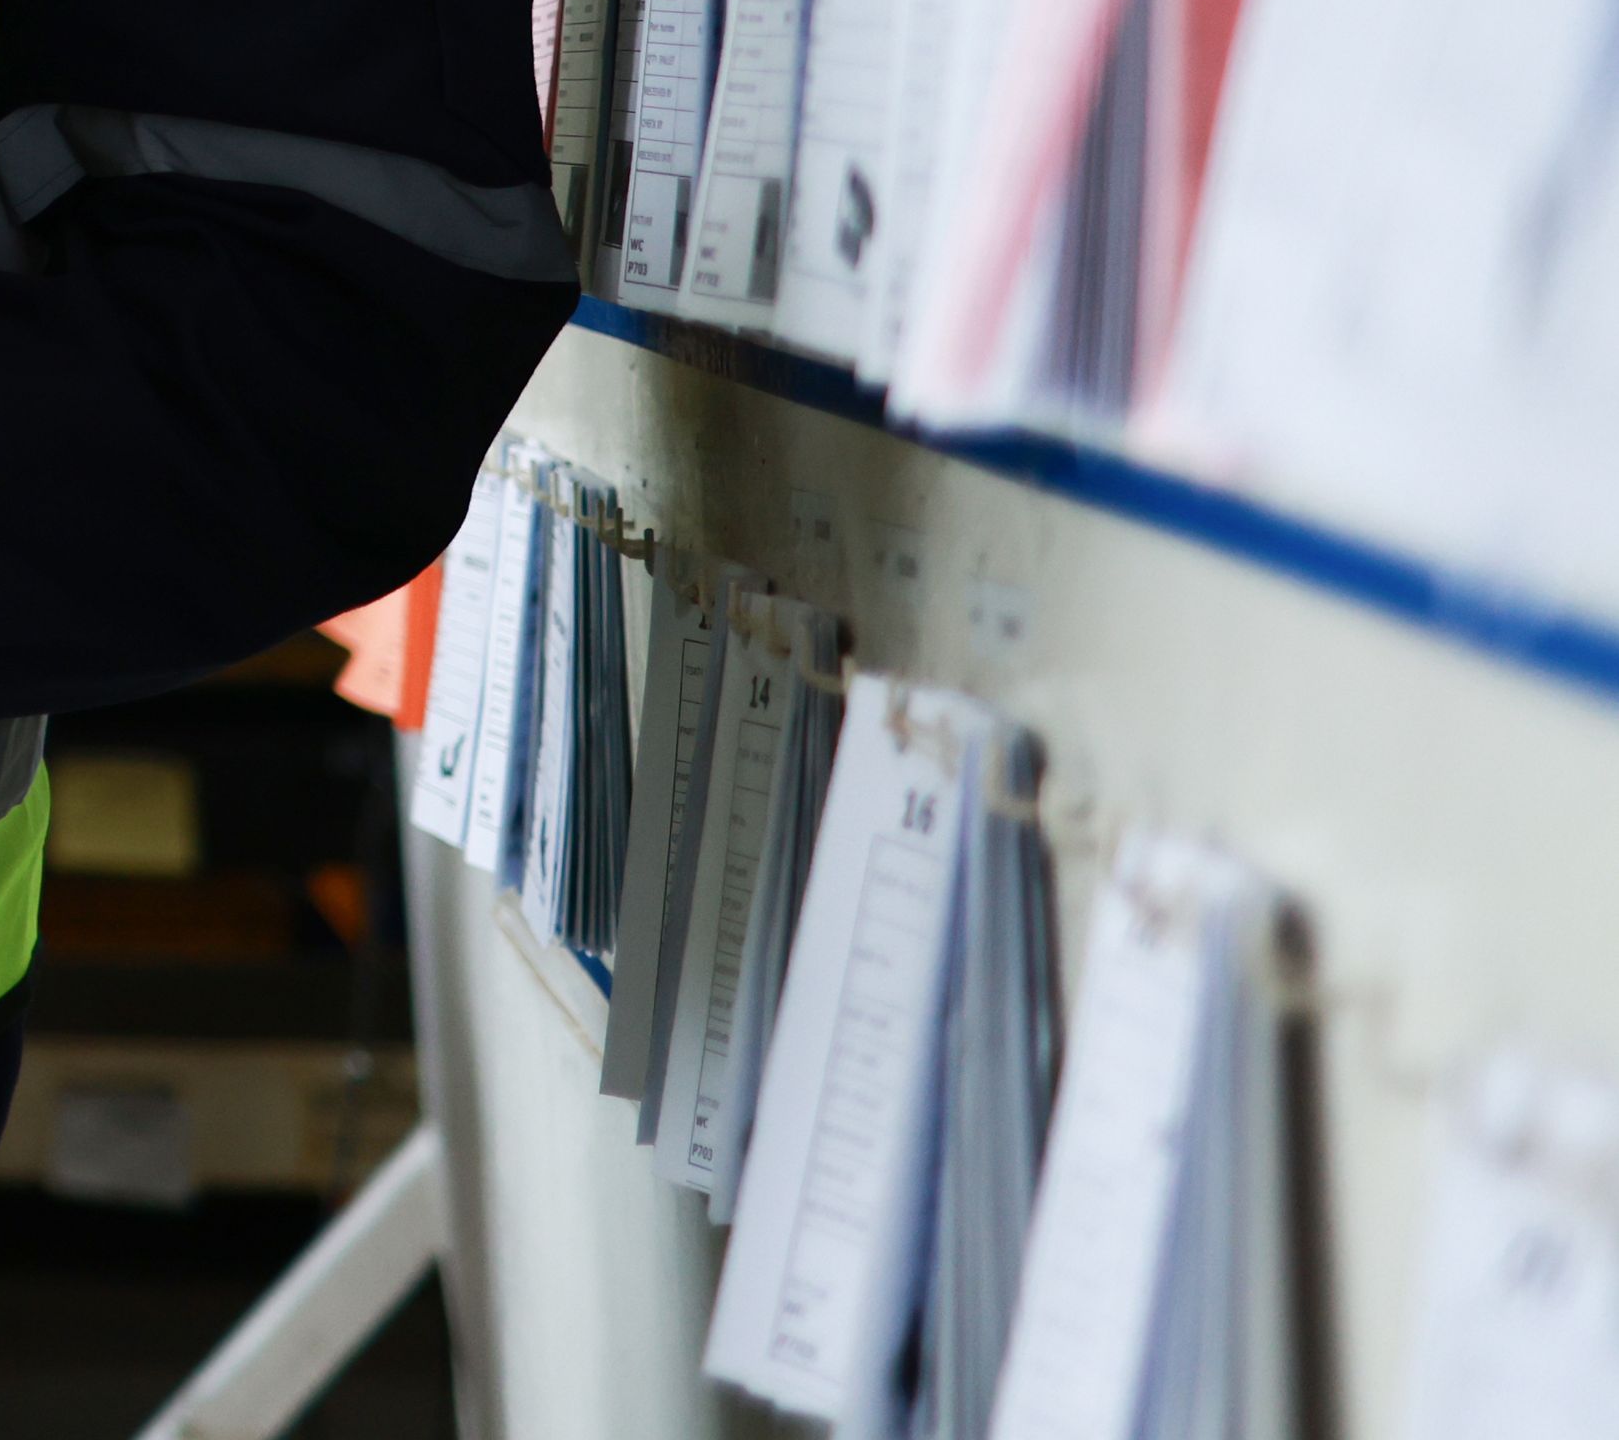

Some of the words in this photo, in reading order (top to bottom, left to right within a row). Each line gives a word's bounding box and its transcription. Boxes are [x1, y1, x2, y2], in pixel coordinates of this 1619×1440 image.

[630, 238, 645, 253] WC
[628, 260, 648, 277] P703
[748, 674, 771, 712] 14
[902, 786, 938, 836] 16
[692, 1142, 714, 1163] P703
